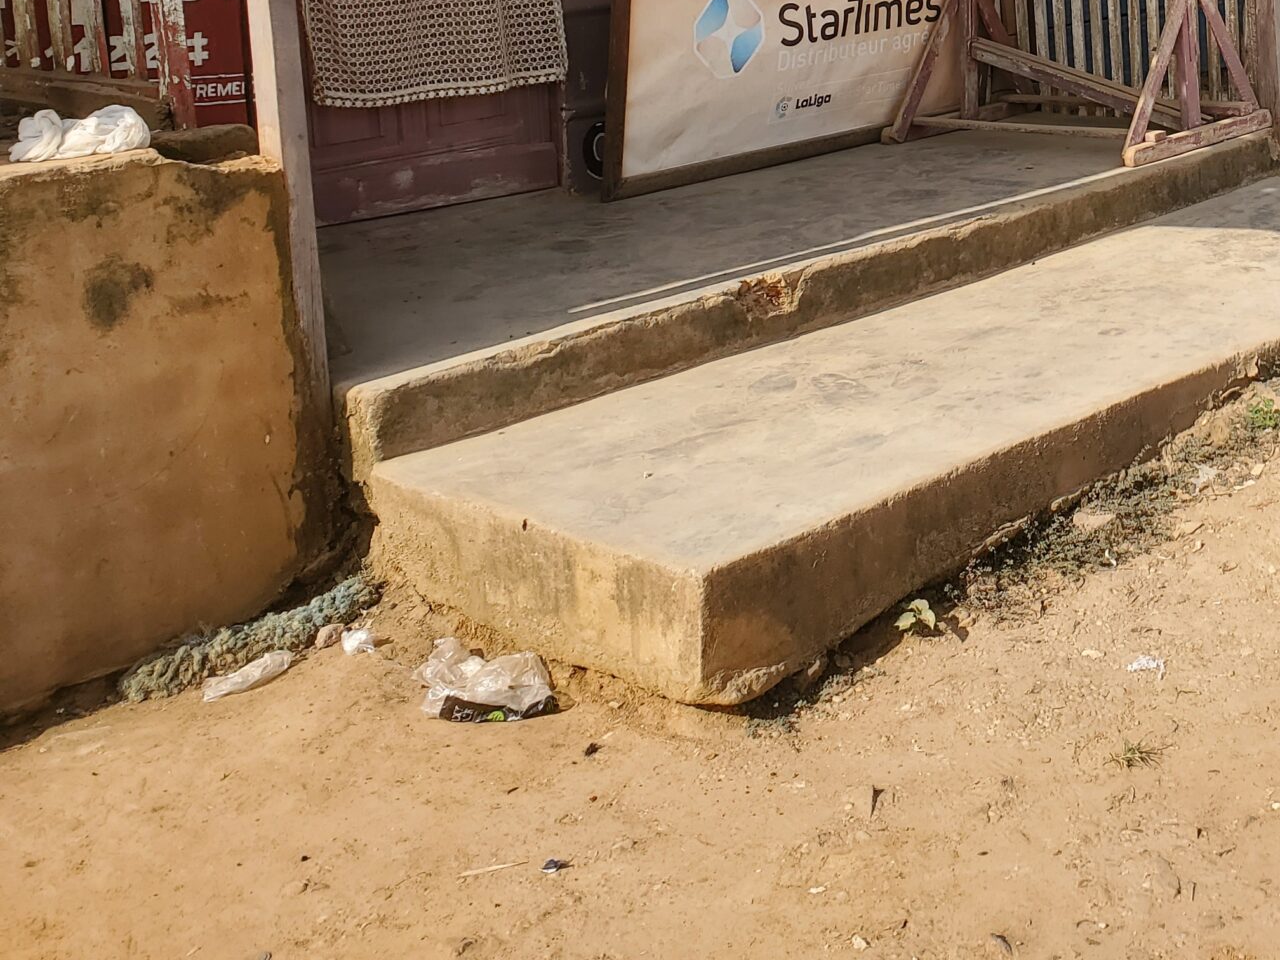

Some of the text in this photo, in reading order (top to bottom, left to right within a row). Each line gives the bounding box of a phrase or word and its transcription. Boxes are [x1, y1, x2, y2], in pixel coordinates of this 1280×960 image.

[777, 25, 931, 73] Distributeur agré
[795, 92, 832, 110] LaLiga
